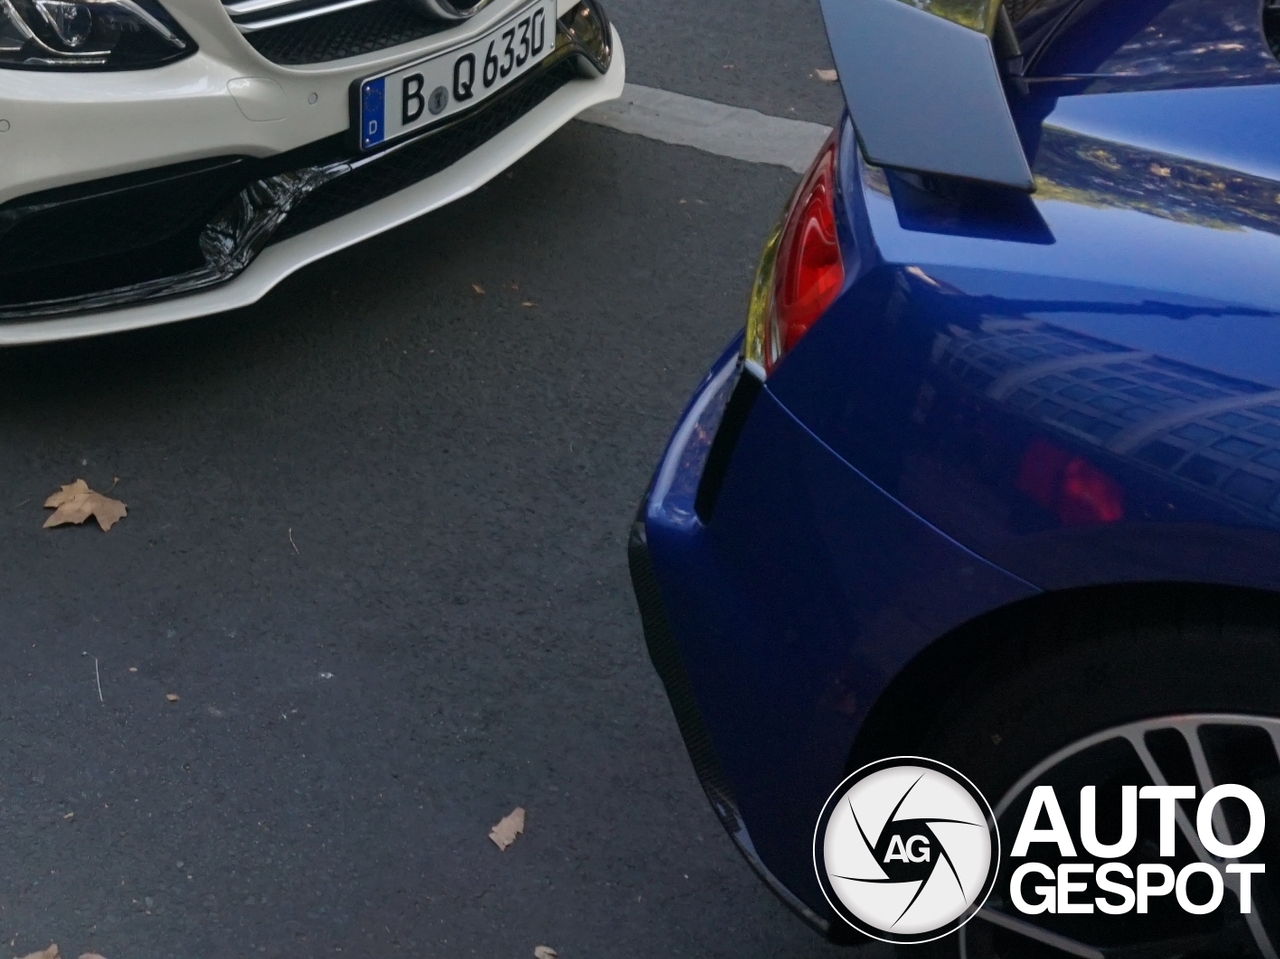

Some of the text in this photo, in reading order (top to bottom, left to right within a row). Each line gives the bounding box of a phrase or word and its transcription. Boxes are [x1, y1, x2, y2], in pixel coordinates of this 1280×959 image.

[402, 7, 545, 125] B Q 6330
[368, 120, 377, 134] D
